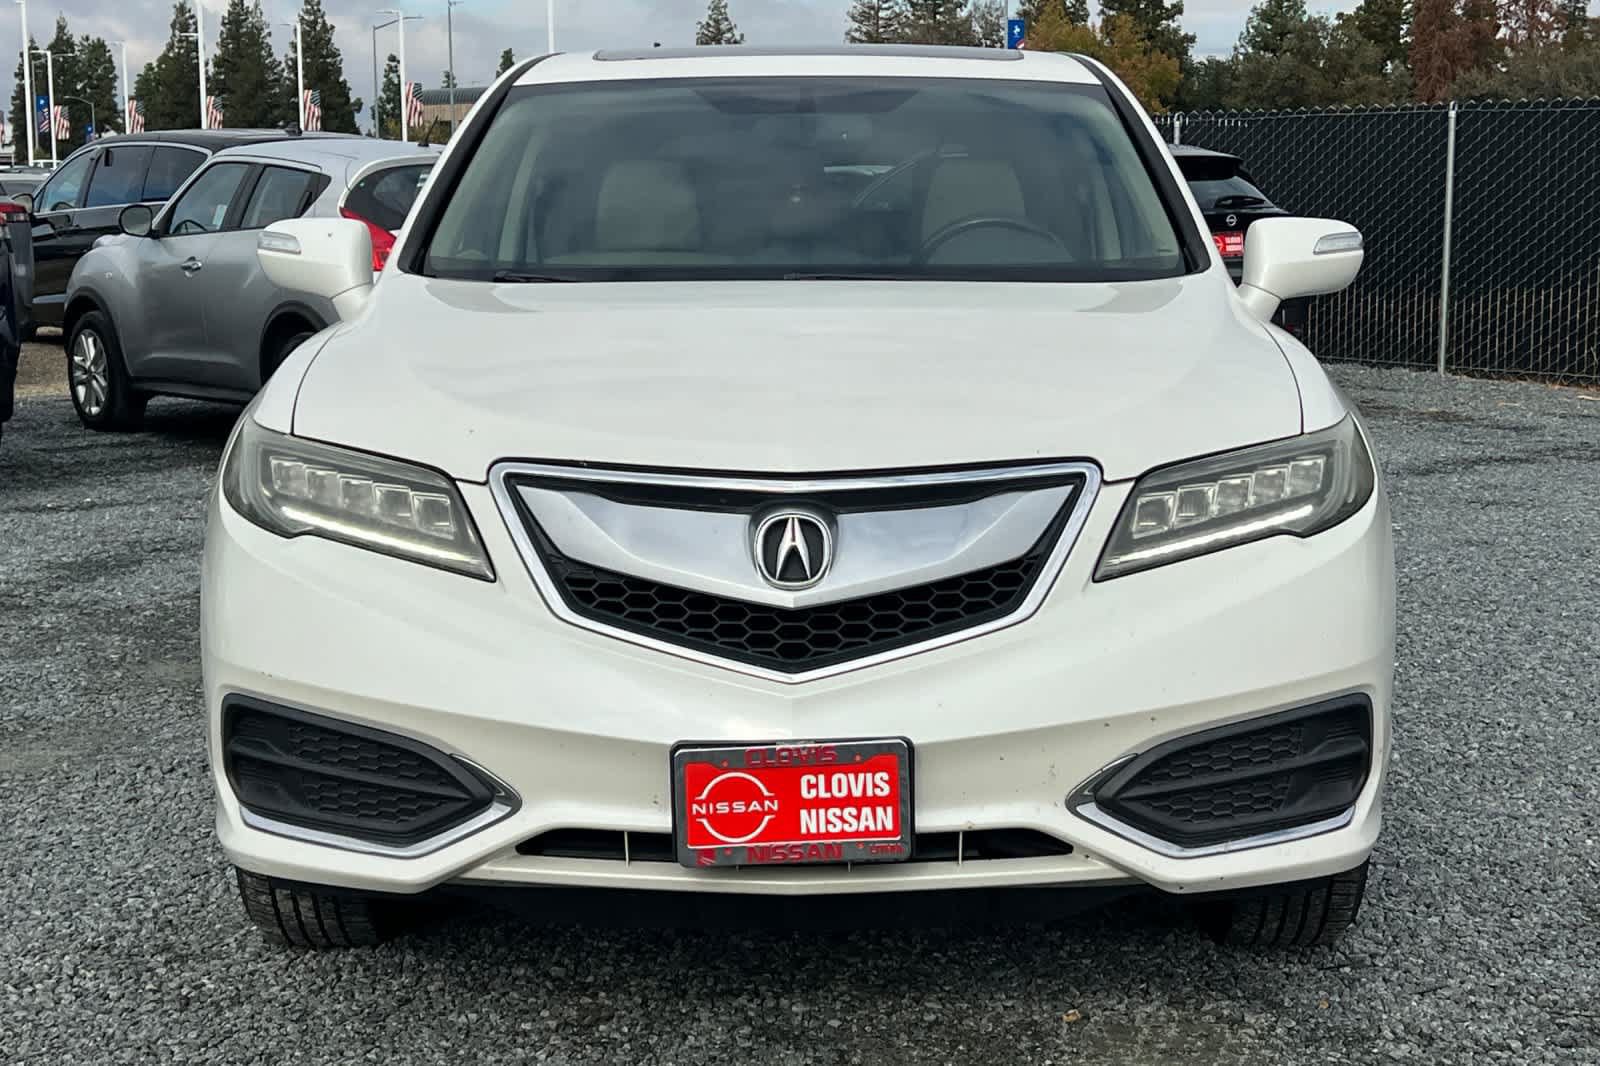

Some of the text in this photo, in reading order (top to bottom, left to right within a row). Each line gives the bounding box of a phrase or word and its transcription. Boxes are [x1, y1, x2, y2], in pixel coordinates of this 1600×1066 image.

[800, 772, 891, 799] CLOVIS
[692, 800, 779, 815] NISSAN
[800, 806, 894, 835] NISSAN
[746, 844, 843, 863] NISSAN
